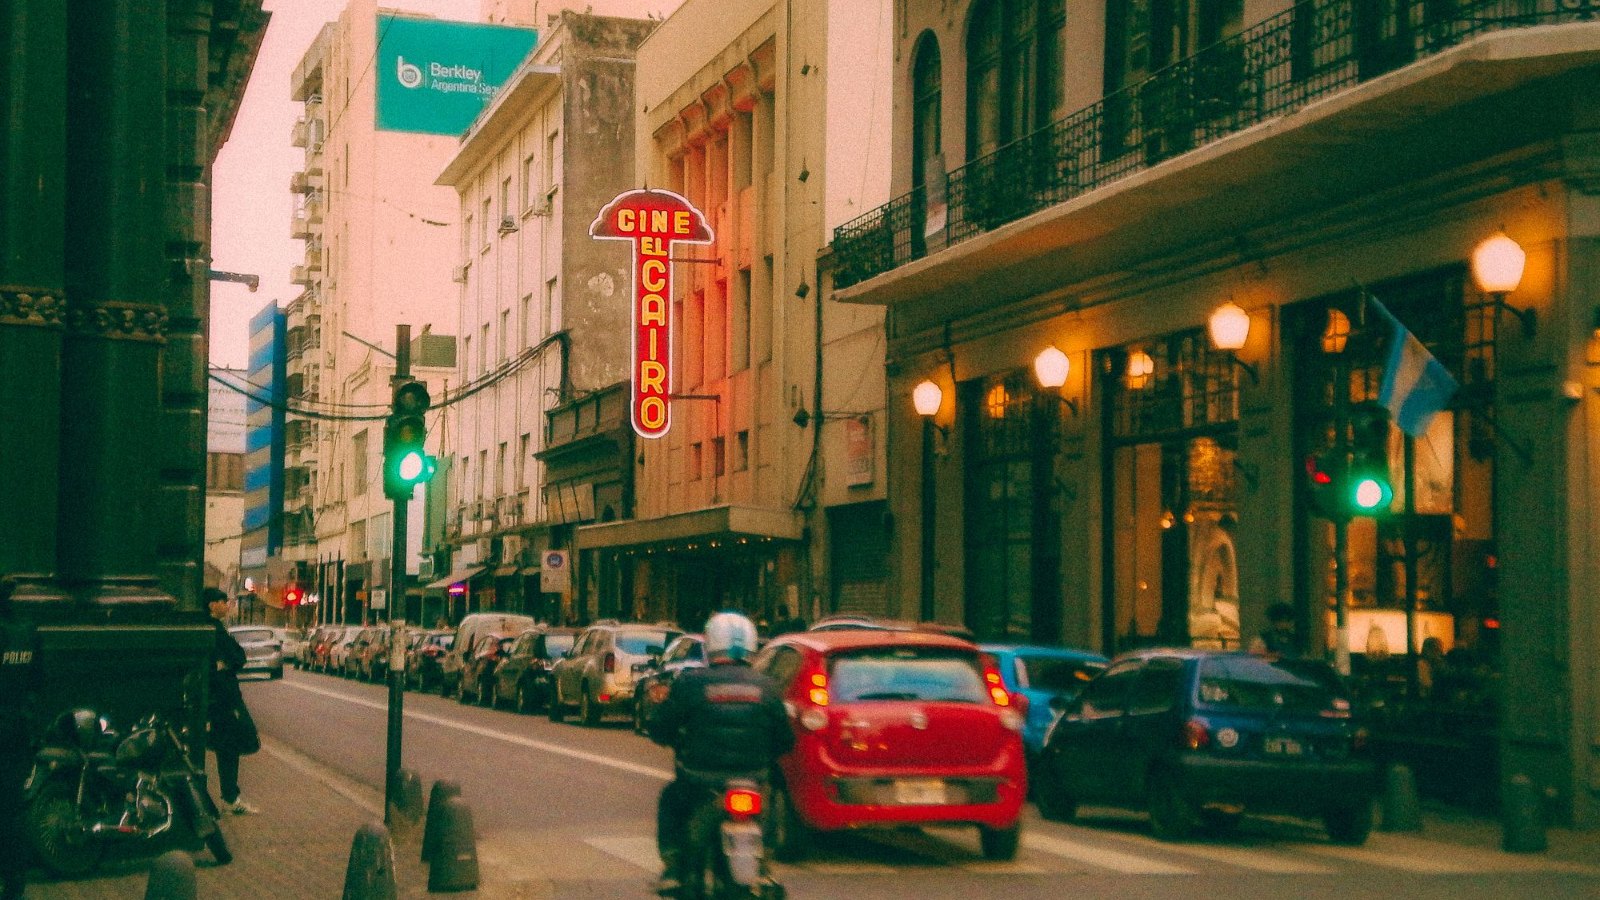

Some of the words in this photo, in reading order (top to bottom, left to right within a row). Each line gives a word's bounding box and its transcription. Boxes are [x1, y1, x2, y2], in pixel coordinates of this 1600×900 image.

[430, 62, 481, 83] Berkley
[431, 79, 477, 94] Argentina
[617, 208, 690, 234] CINE
[641, 236, 668, 256] EL
[640, 259, 666, 430] CAIRO
